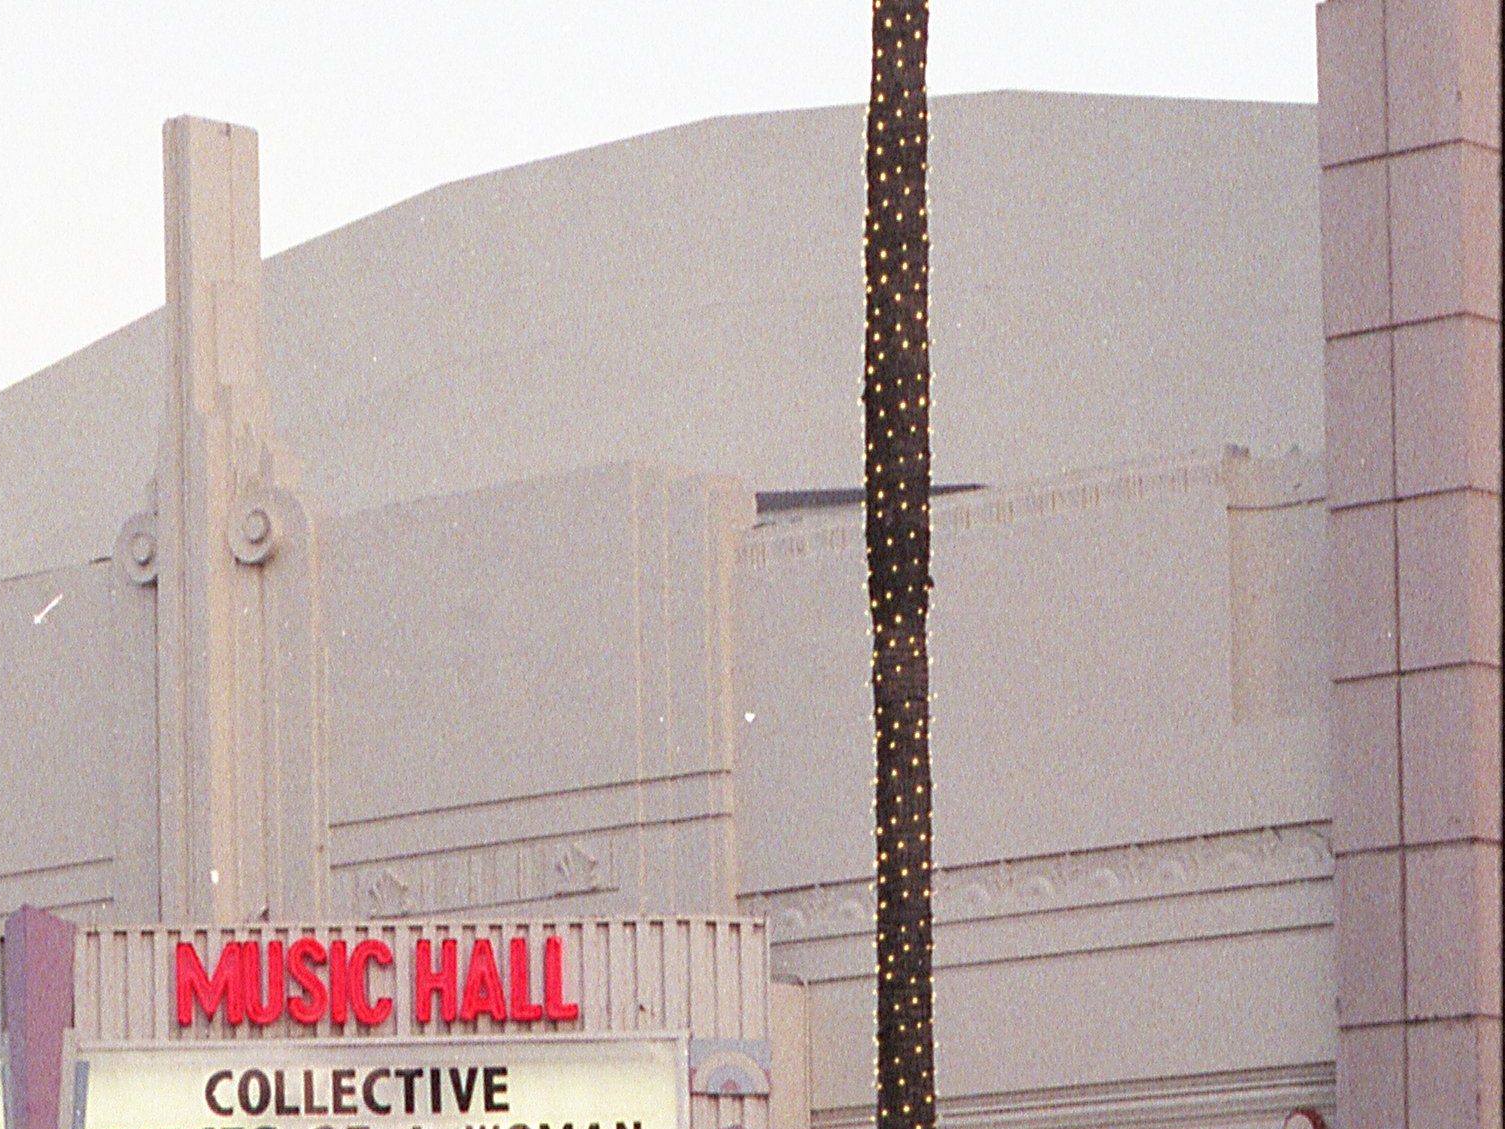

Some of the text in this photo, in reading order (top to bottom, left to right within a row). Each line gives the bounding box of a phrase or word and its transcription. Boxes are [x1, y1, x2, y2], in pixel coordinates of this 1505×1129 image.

[174, 935, 580, 1027] MUSIC HALL
[205, 1065, 511, 1116] COLLECTIVE
